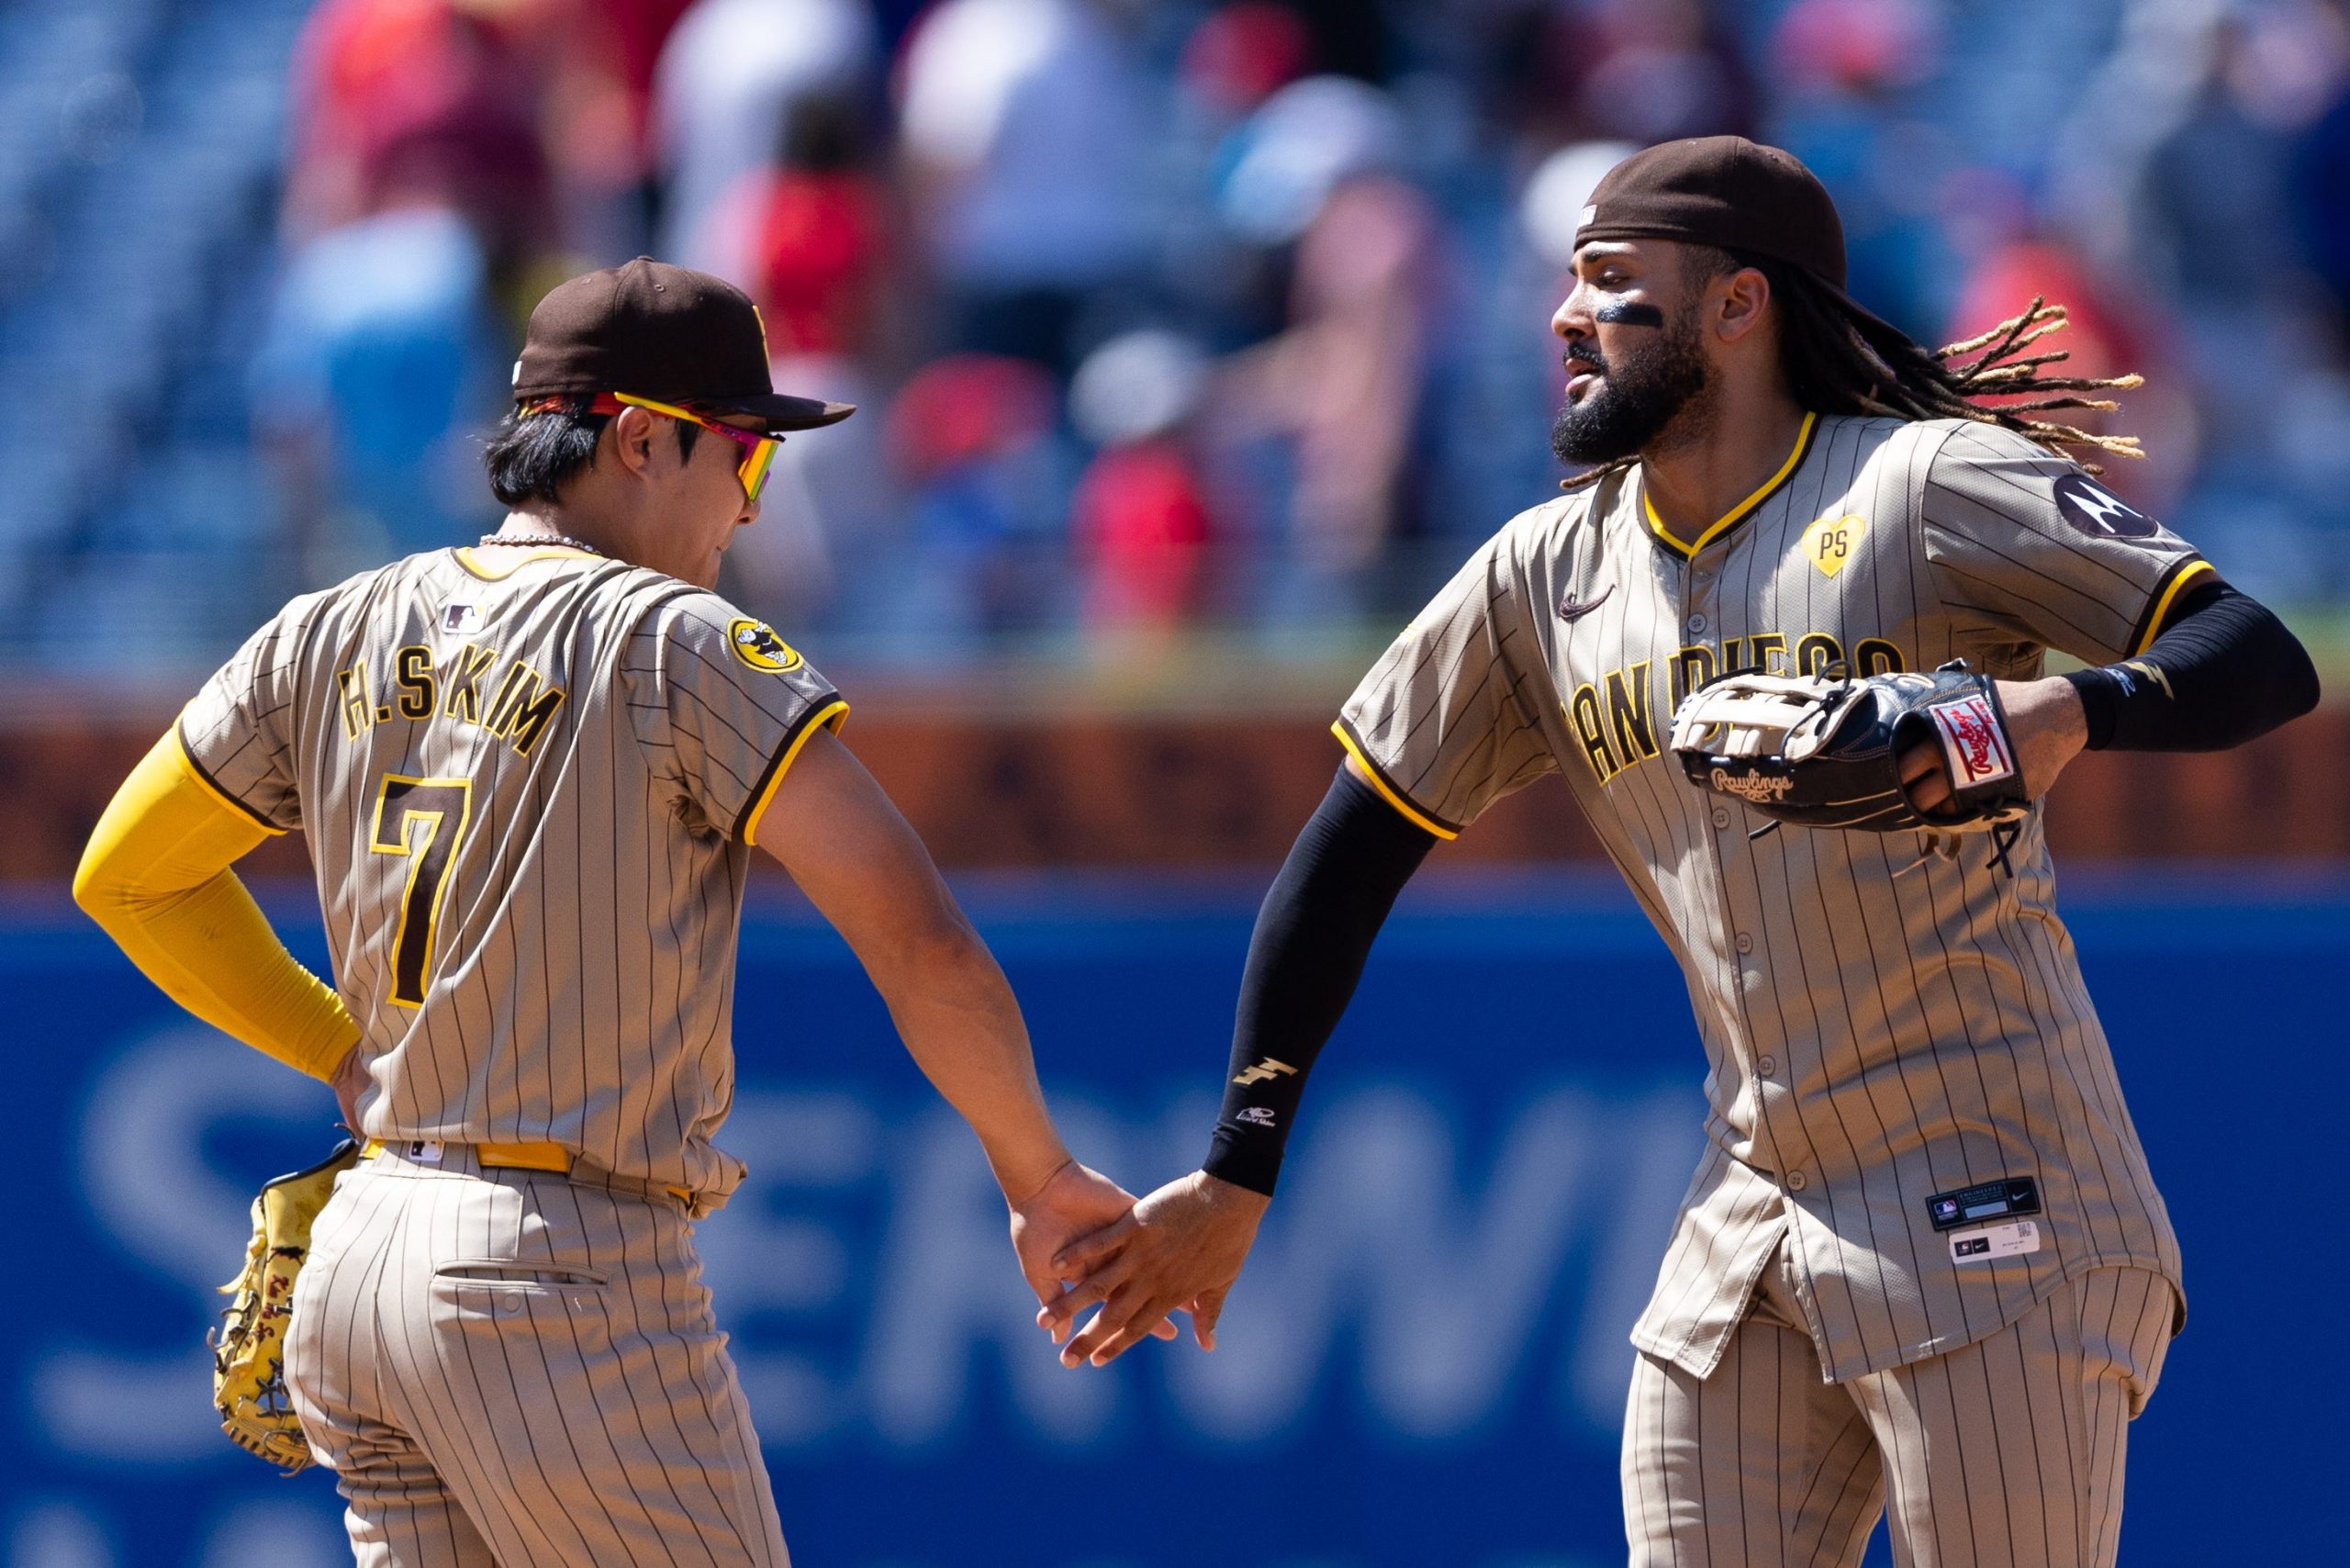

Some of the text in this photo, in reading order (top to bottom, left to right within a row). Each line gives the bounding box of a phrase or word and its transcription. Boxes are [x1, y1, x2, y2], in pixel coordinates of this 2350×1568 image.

[1819, 530, 1848, 560] PS
[1561, 661, 1660, 788] AN
[1710, 767, 1794, 801] Rawlings
[370, 773, 473, 1011] 7
